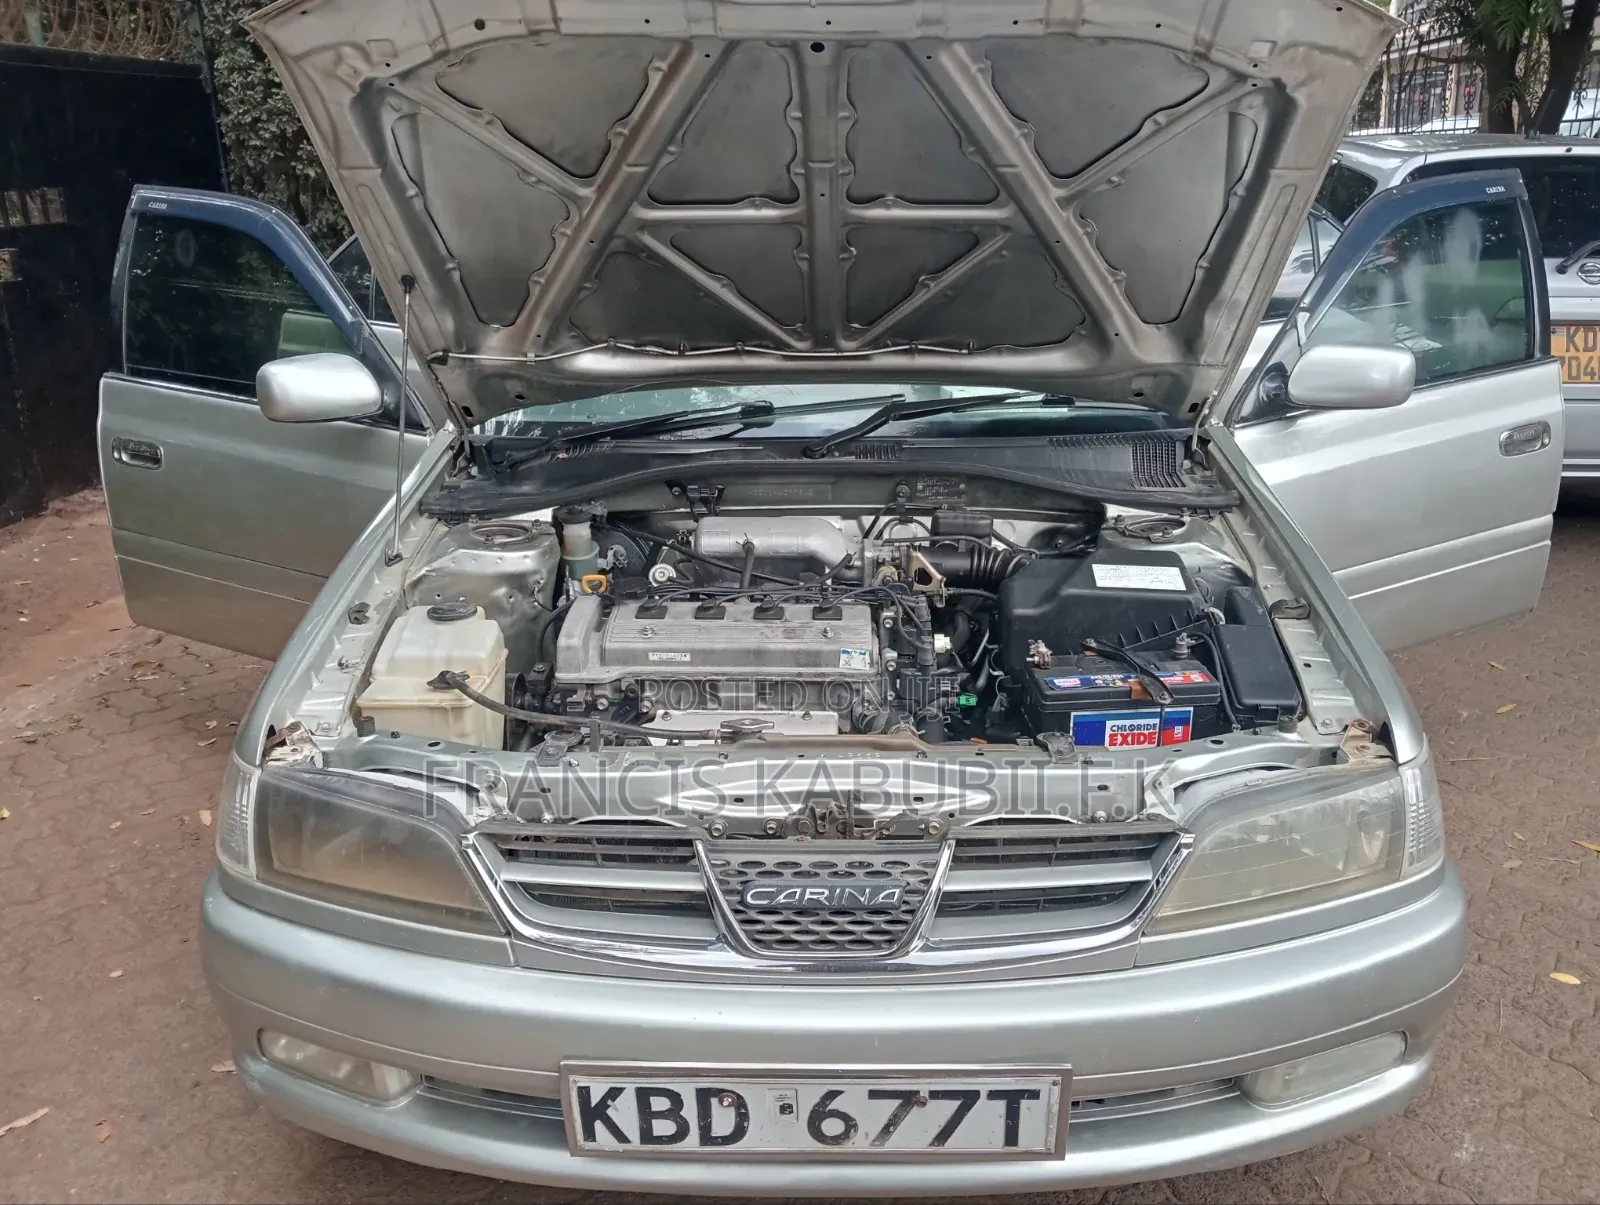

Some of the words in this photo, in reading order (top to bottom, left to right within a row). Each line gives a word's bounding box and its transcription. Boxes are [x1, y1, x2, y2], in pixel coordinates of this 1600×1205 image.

[1566, 326, 1600, 352] KD
[1109, 722, 1158, 732] CHLORIDE
[1108, 731, 1158, 747] EXIDE
[746, 887, 902, 907] CARINA
[576, 1085, 750, 1147] KBD
[806, 1088, 1041, 1148] 677T
